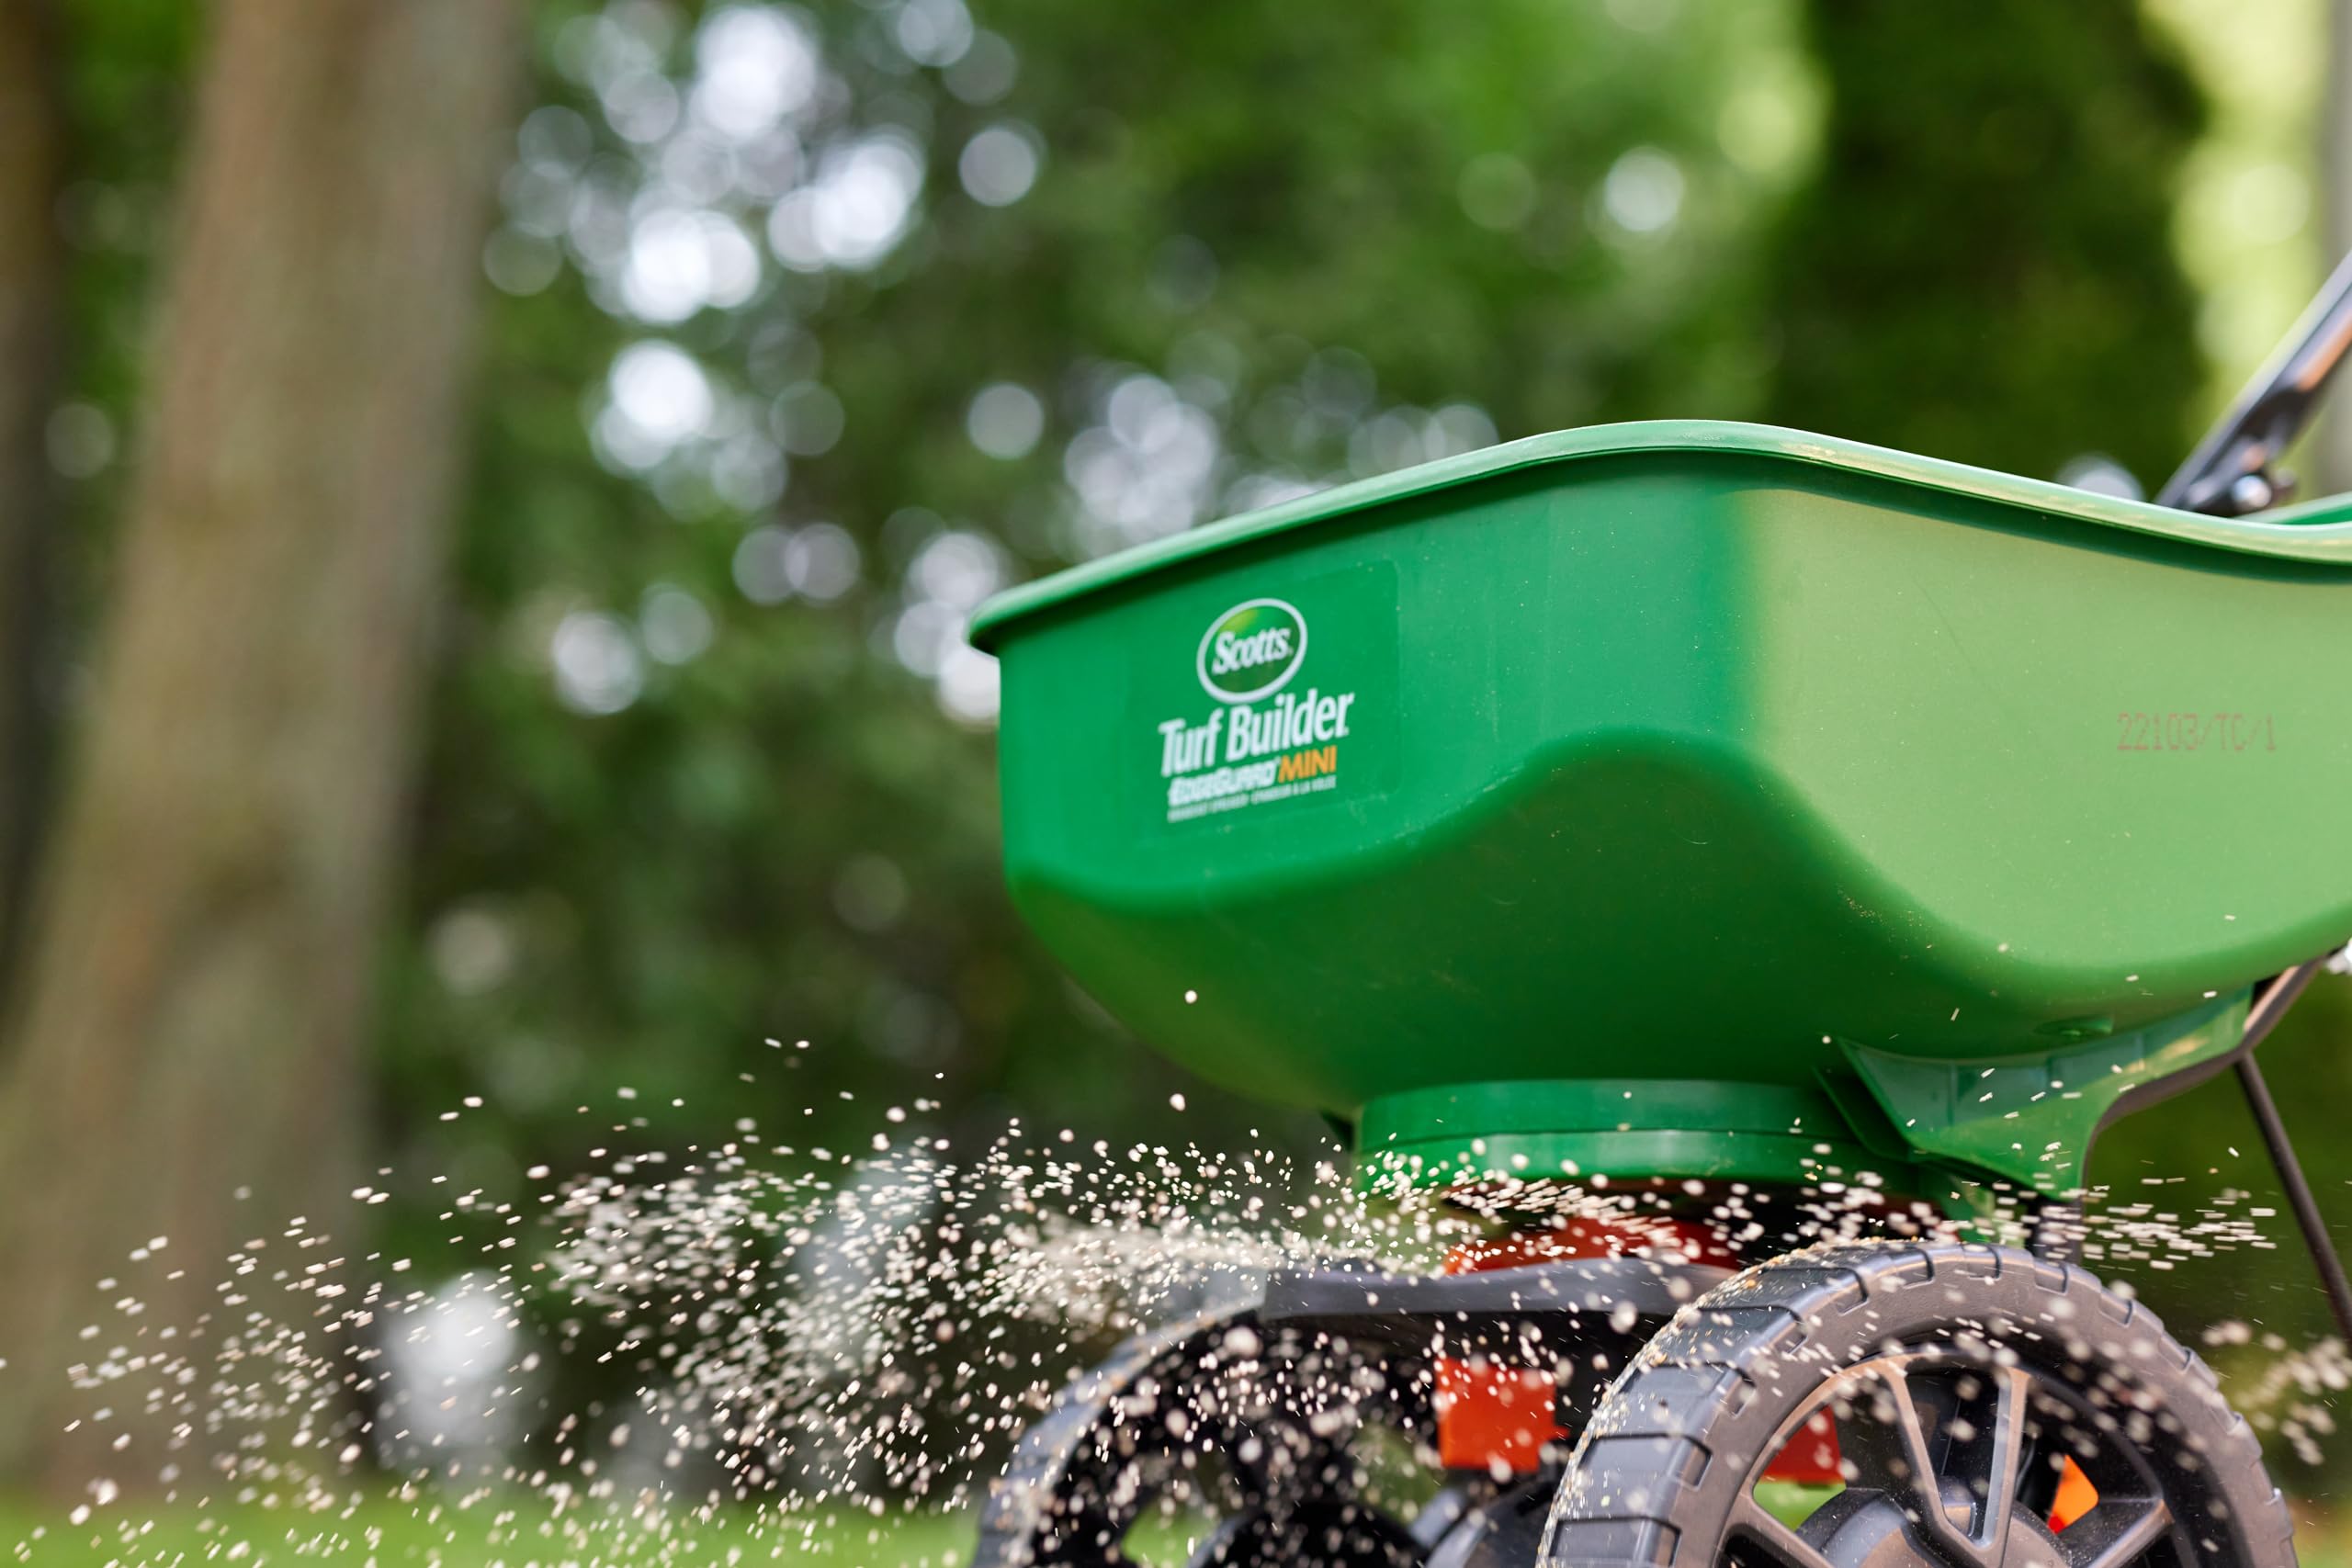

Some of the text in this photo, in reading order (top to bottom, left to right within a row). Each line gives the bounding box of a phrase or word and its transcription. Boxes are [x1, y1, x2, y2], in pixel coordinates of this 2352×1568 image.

[1212, 628, 1291, 674] Scotts
[1158, 688, 1355, 777] Turf Builder
[1278, 745, 1337, 784] MINI
